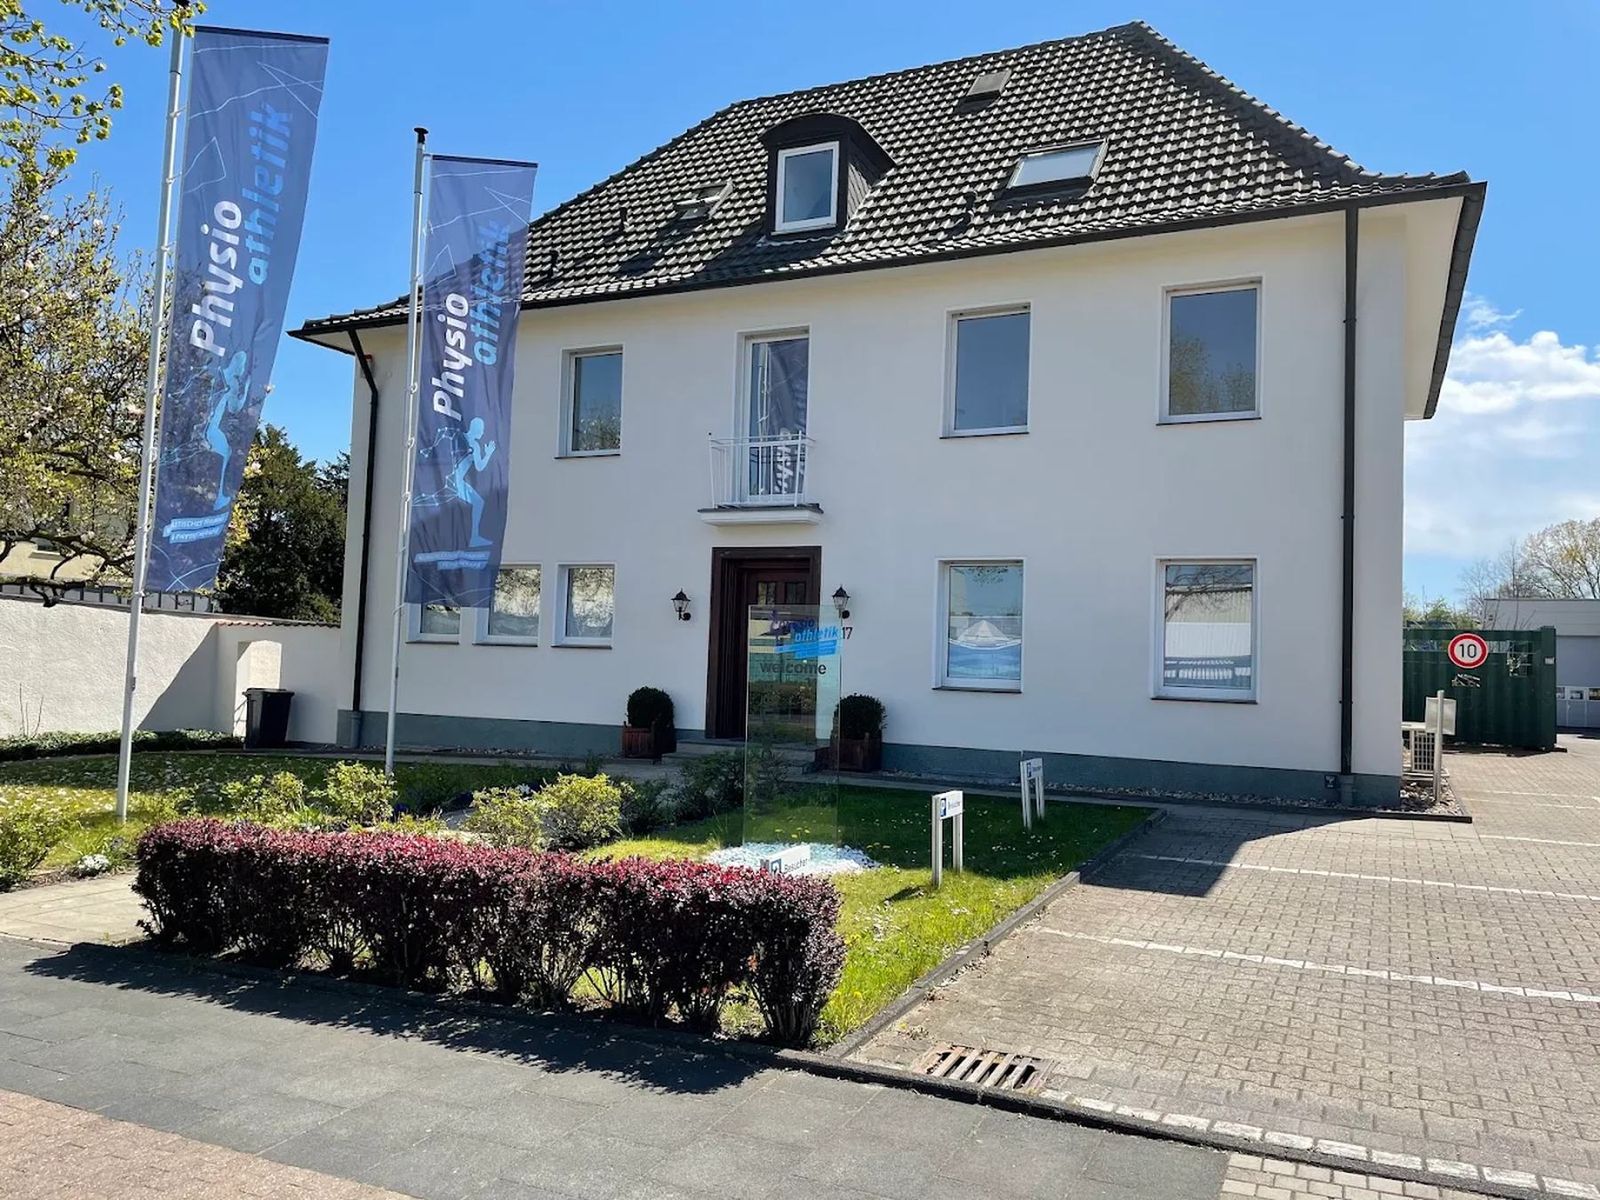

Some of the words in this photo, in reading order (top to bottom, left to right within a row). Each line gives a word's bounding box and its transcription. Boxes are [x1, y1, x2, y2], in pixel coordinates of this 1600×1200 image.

[242, 102, 293, 285] athletik
[189, 200, 243, 357] Physio
[470, 219, 510, 366] athletik
[431, 292, 473, 422] Physio
[842, 626, 853, 640] 17
[1459, 643, 1477, 658] 10
